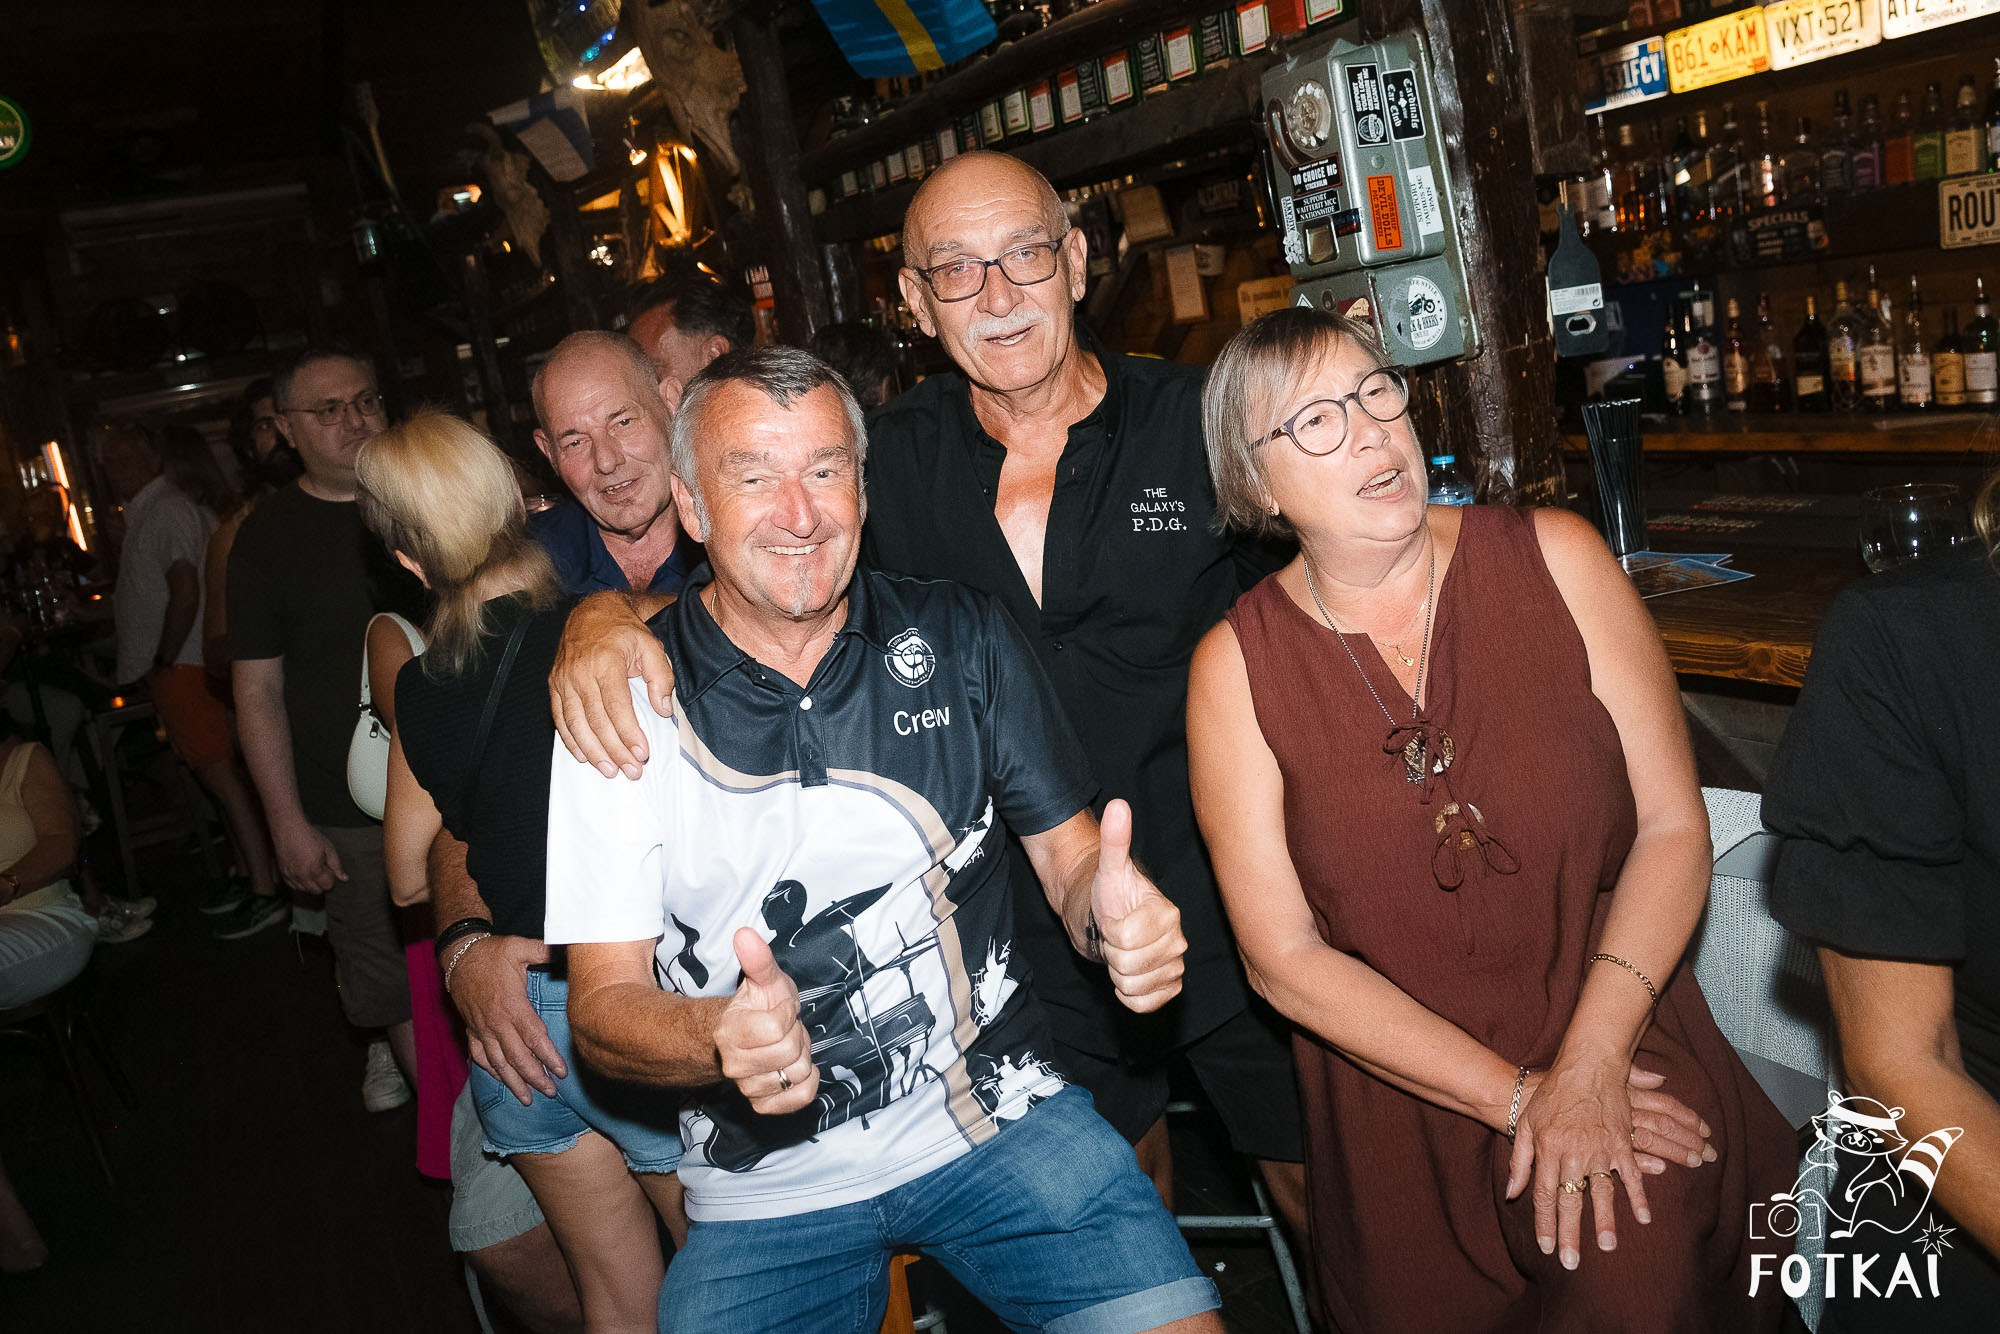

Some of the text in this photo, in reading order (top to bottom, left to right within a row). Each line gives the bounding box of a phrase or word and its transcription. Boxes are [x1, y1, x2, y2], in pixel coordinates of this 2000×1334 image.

[1352, 82, 1362, 112] SUPPORT
[1357, 71, 1368, 112] YOUR LOCAL
[1387, 83, 1396, 102] Car
[1403, 78, 1419, 129] Cardinals
[1390, 105, 1402, 127] Club
[1292, 163, 1338, 186] NO CHOICE MC
[1303, 193, 1327, 206] SUPPORT
[1324, 197, 1337, 207] MCC
[1377, 180, 1393, 246] DEVIL DOLLS
[1387, 193, 1397, 230] WORSHIP
[1410, 183, 1423, 223] SUPPORT
[1416, 175, 1431, 227] TAURUS MC
[1425, 186, 1436, 212] SPAIN
[1949, 188, 2000, 231] ROU
[1300, 206, 1335, 221] NATIONWIDE
[1371, 190, 1384, 237] MC SWEDEN
[1130, 500, 1186, 513] GALAXY'S
[1143, 487, 1168, 498] THE
[1132, 517, 1188, 532] P.D.G.
[893, 706, 950, 736] Crew
